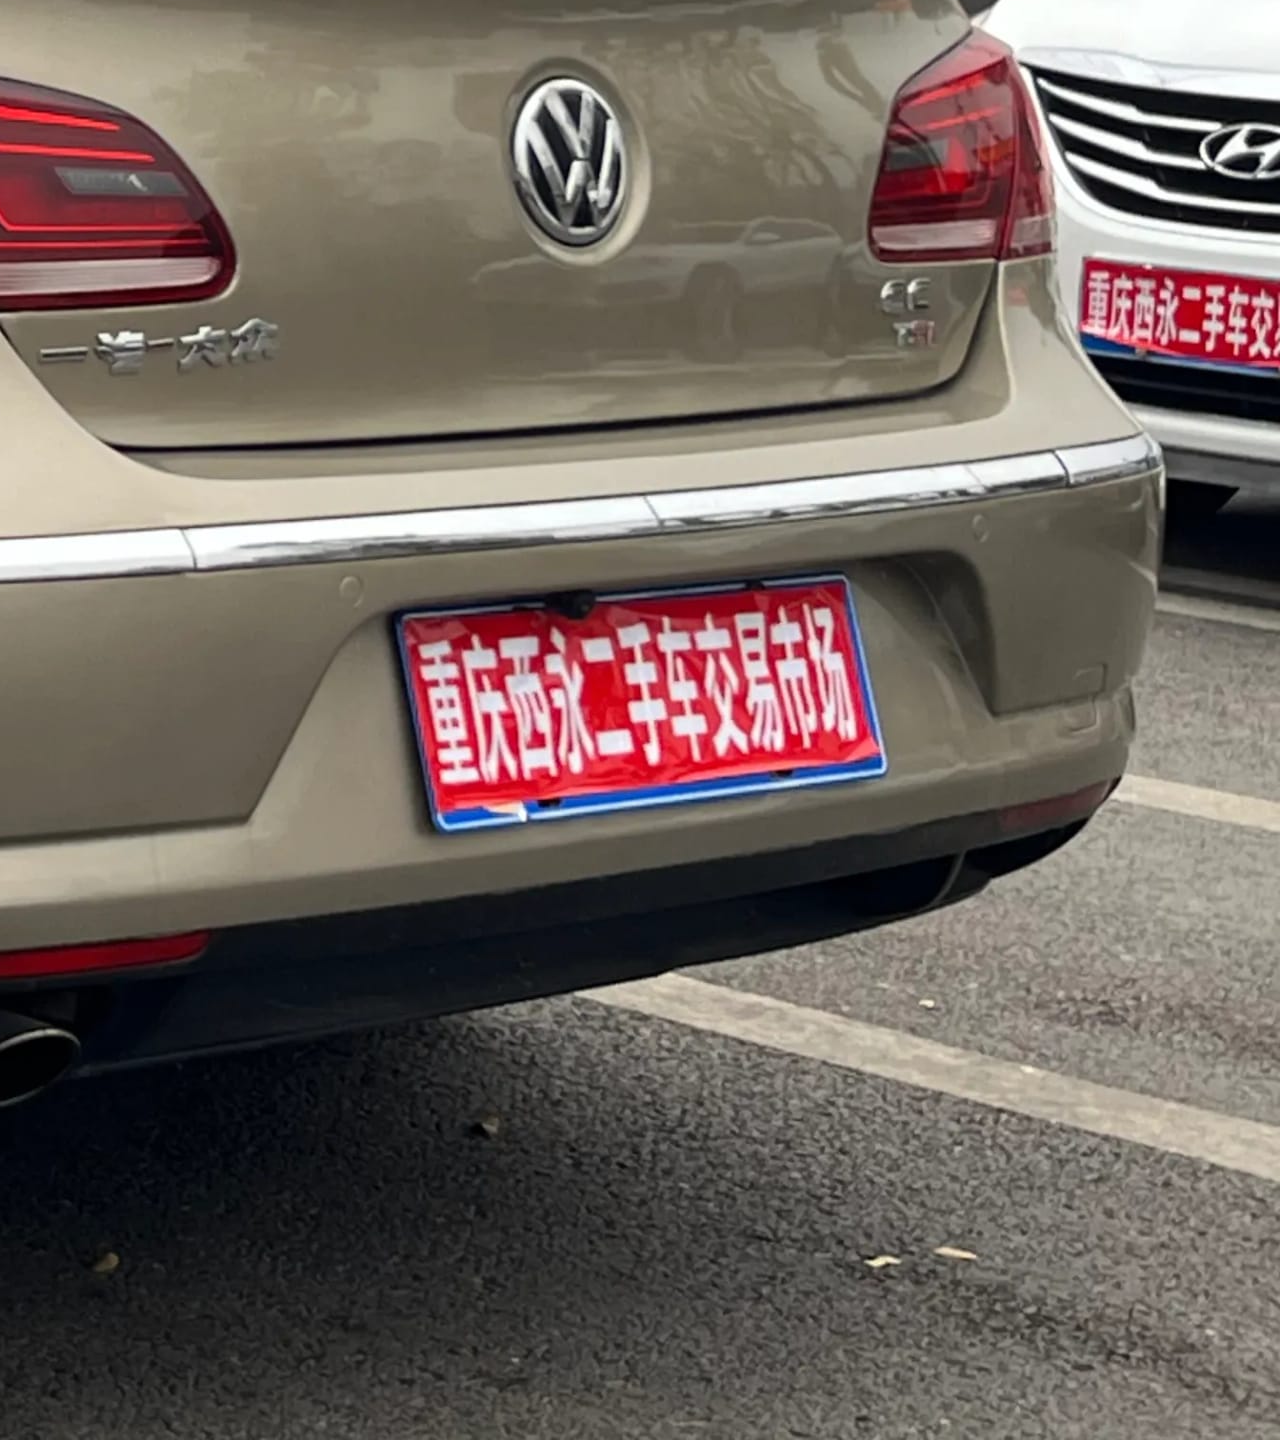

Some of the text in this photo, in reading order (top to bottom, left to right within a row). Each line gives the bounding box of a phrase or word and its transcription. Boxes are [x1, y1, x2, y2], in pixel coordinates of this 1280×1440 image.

[1083, 271, 1280, 360] 重庆西永二手车交
[418, 603, 857, 785] 重庆西永二手车交易市场
